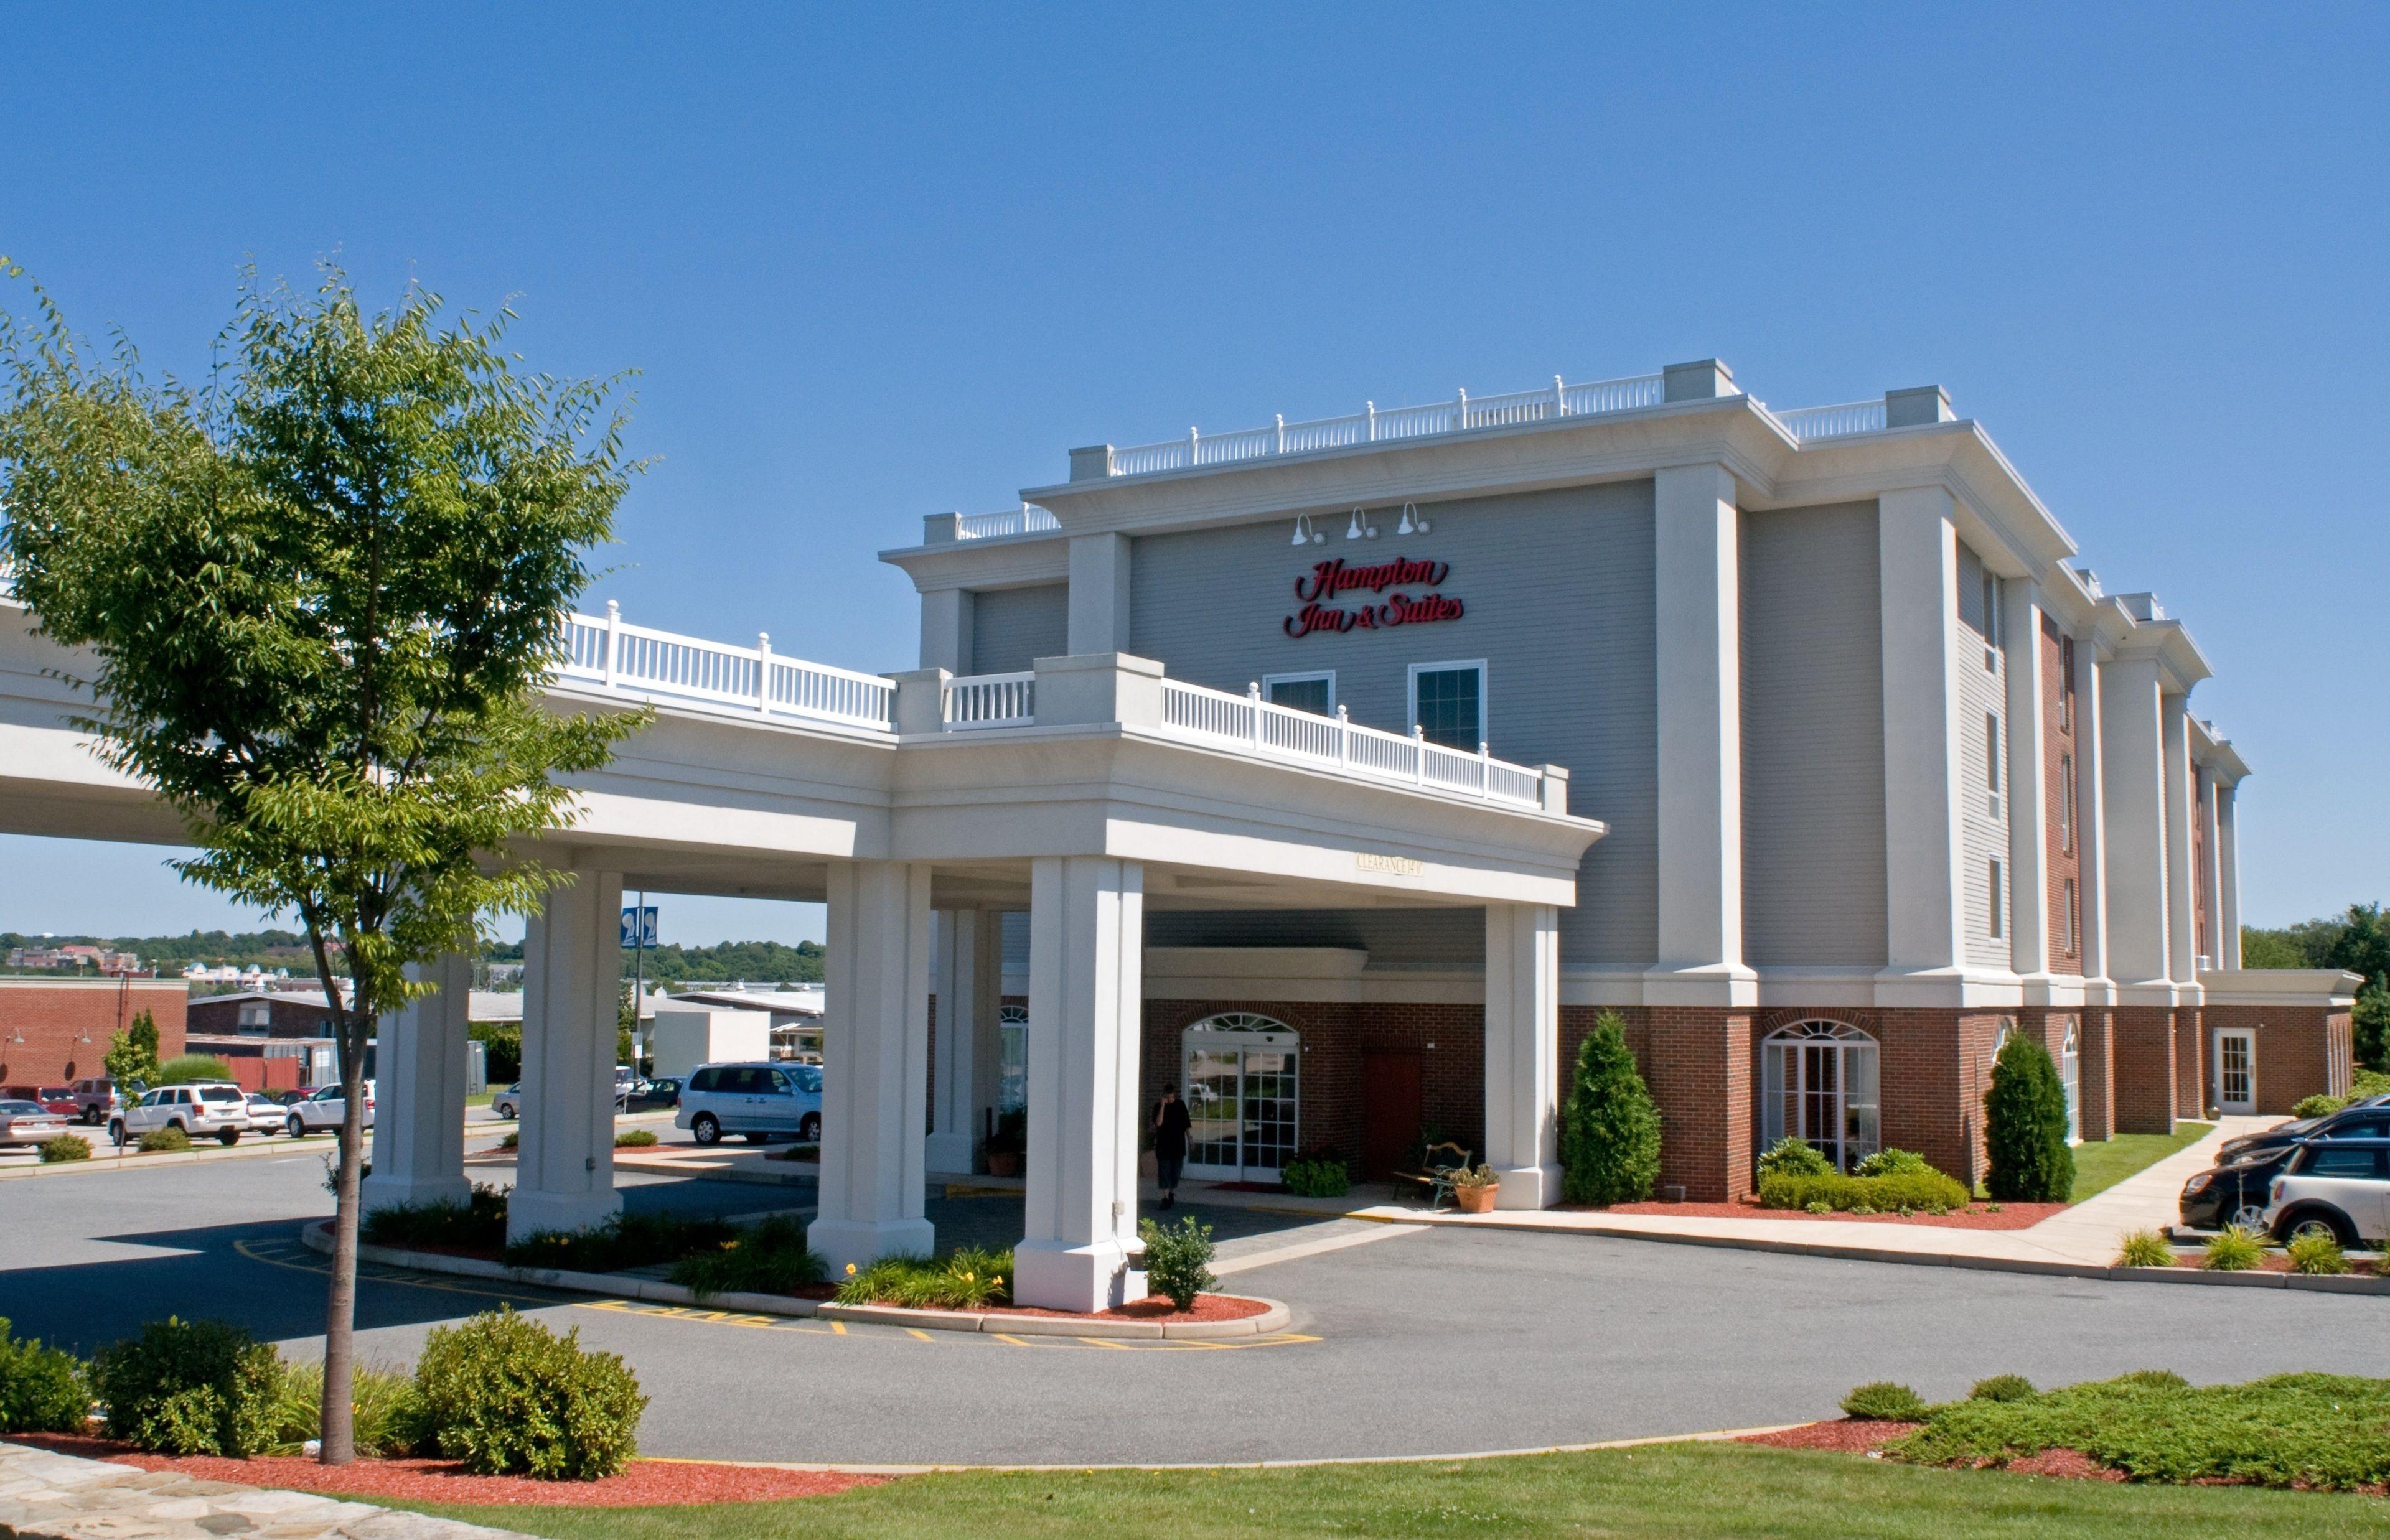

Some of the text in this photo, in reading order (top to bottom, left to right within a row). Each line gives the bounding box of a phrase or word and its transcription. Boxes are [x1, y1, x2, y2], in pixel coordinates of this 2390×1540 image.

[1296, 557, 1448, 602] Hampton
[1284, 594, 1463, 637] Inn & Suites
[1357, 853, 1405, 873] CLEARANCE
